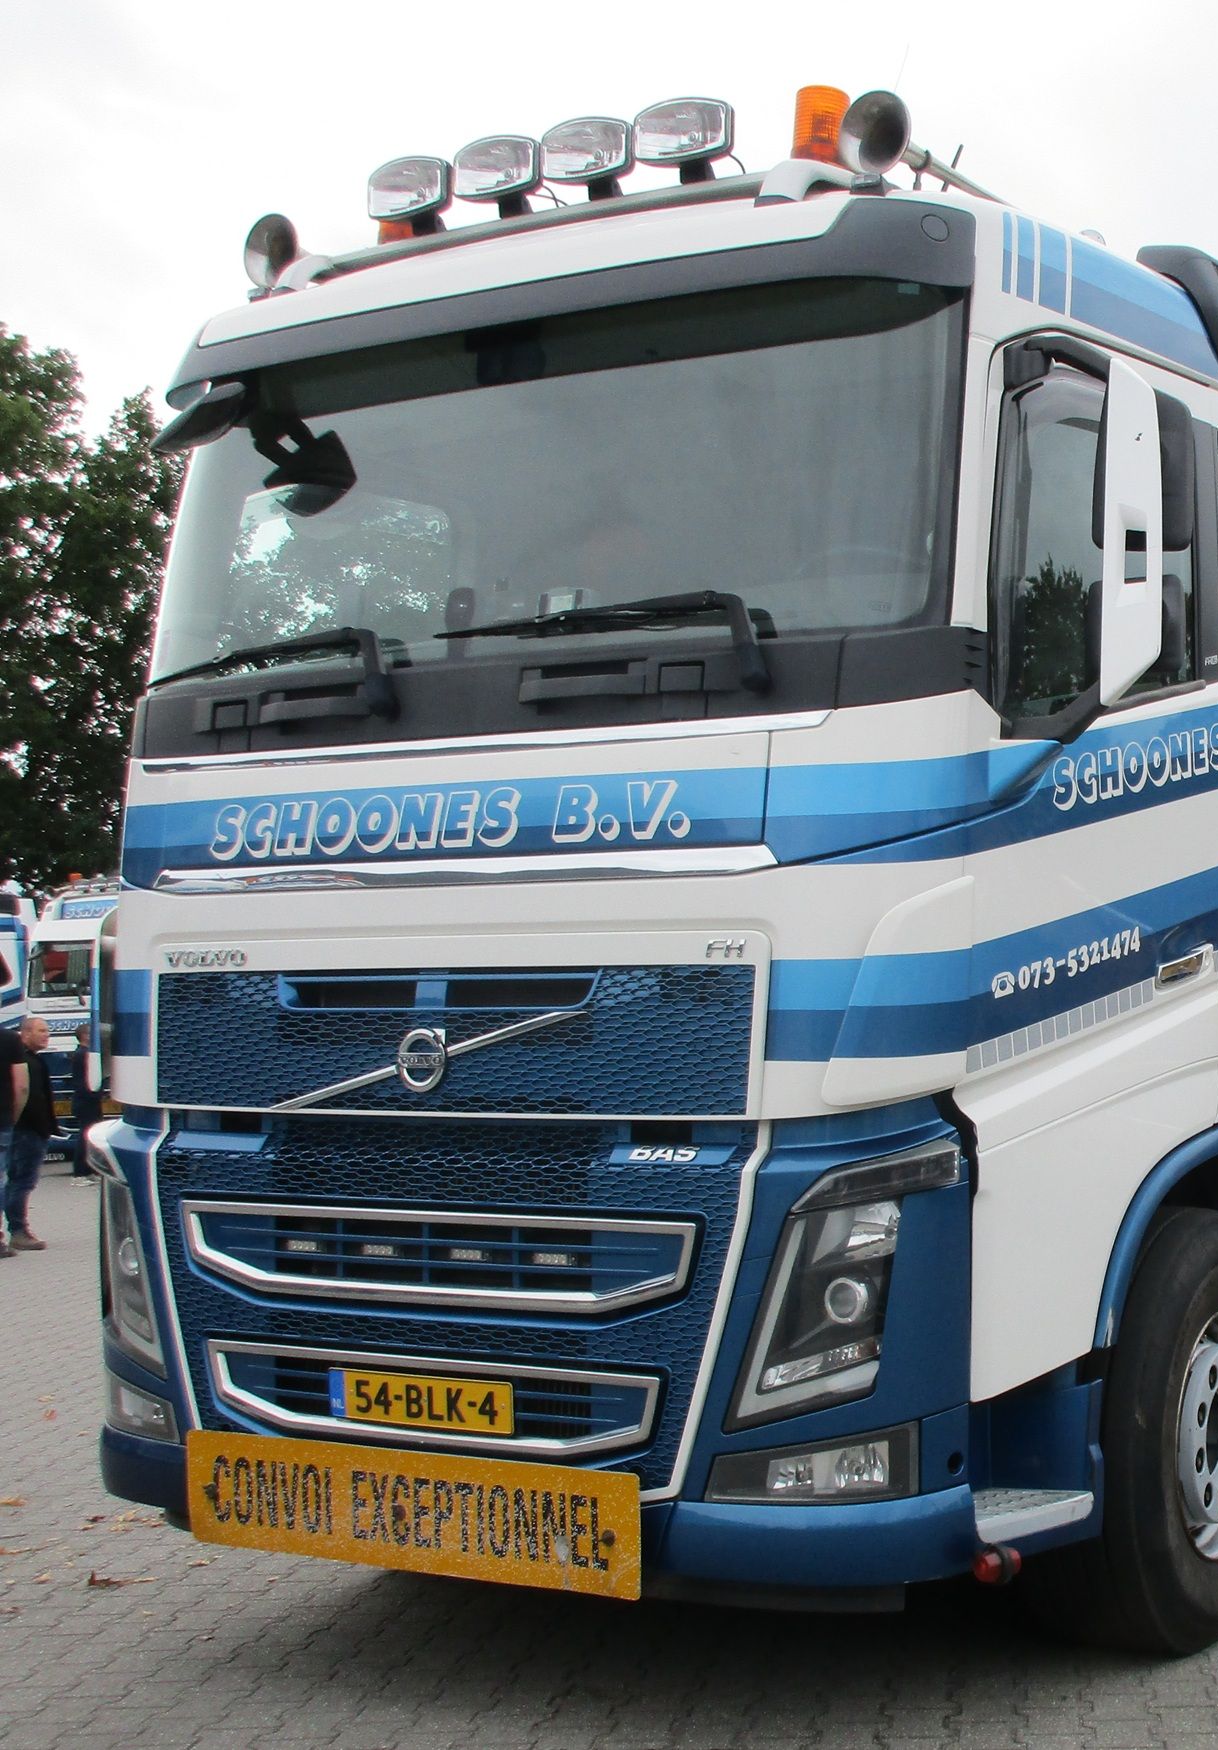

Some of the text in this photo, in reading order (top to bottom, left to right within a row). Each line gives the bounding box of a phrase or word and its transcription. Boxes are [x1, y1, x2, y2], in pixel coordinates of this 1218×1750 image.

[209, 779, 691, 861] SCHOONES B.V.
[164, 948, 247, 968] VOLVO
[705, 938, 746, 958] FH
[1018, 926, 1141, 991] 073-5321474
[399, 1055, 442, 1067] VOLVO
[628, 1144, 700, 1162] BAS
[332, 1397, 345, 1409] NL
[355, 1379, 498, 1426] 54-BLK-4
[211, 1454, 610, 1572] CONVOI EXCEPTIONNEL
